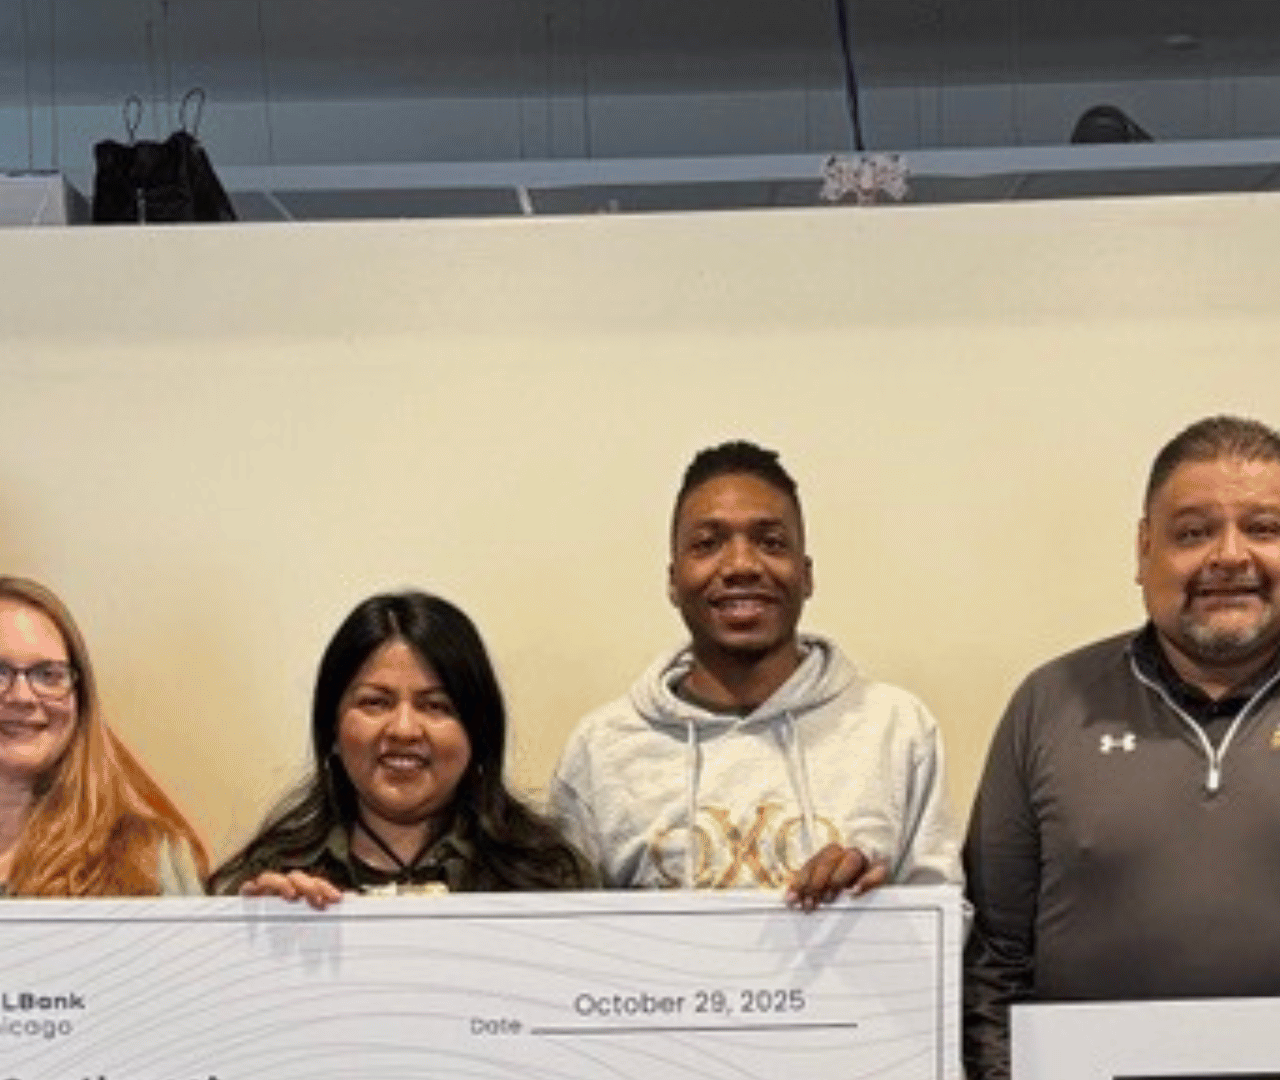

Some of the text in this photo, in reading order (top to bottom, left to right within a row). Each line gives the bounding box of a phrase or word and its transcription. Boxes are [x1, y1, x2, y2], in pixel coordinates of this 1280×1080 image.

[574, 989, 806, 1018] October 29, 2025
[470, 1016, 523, 1036] Date
